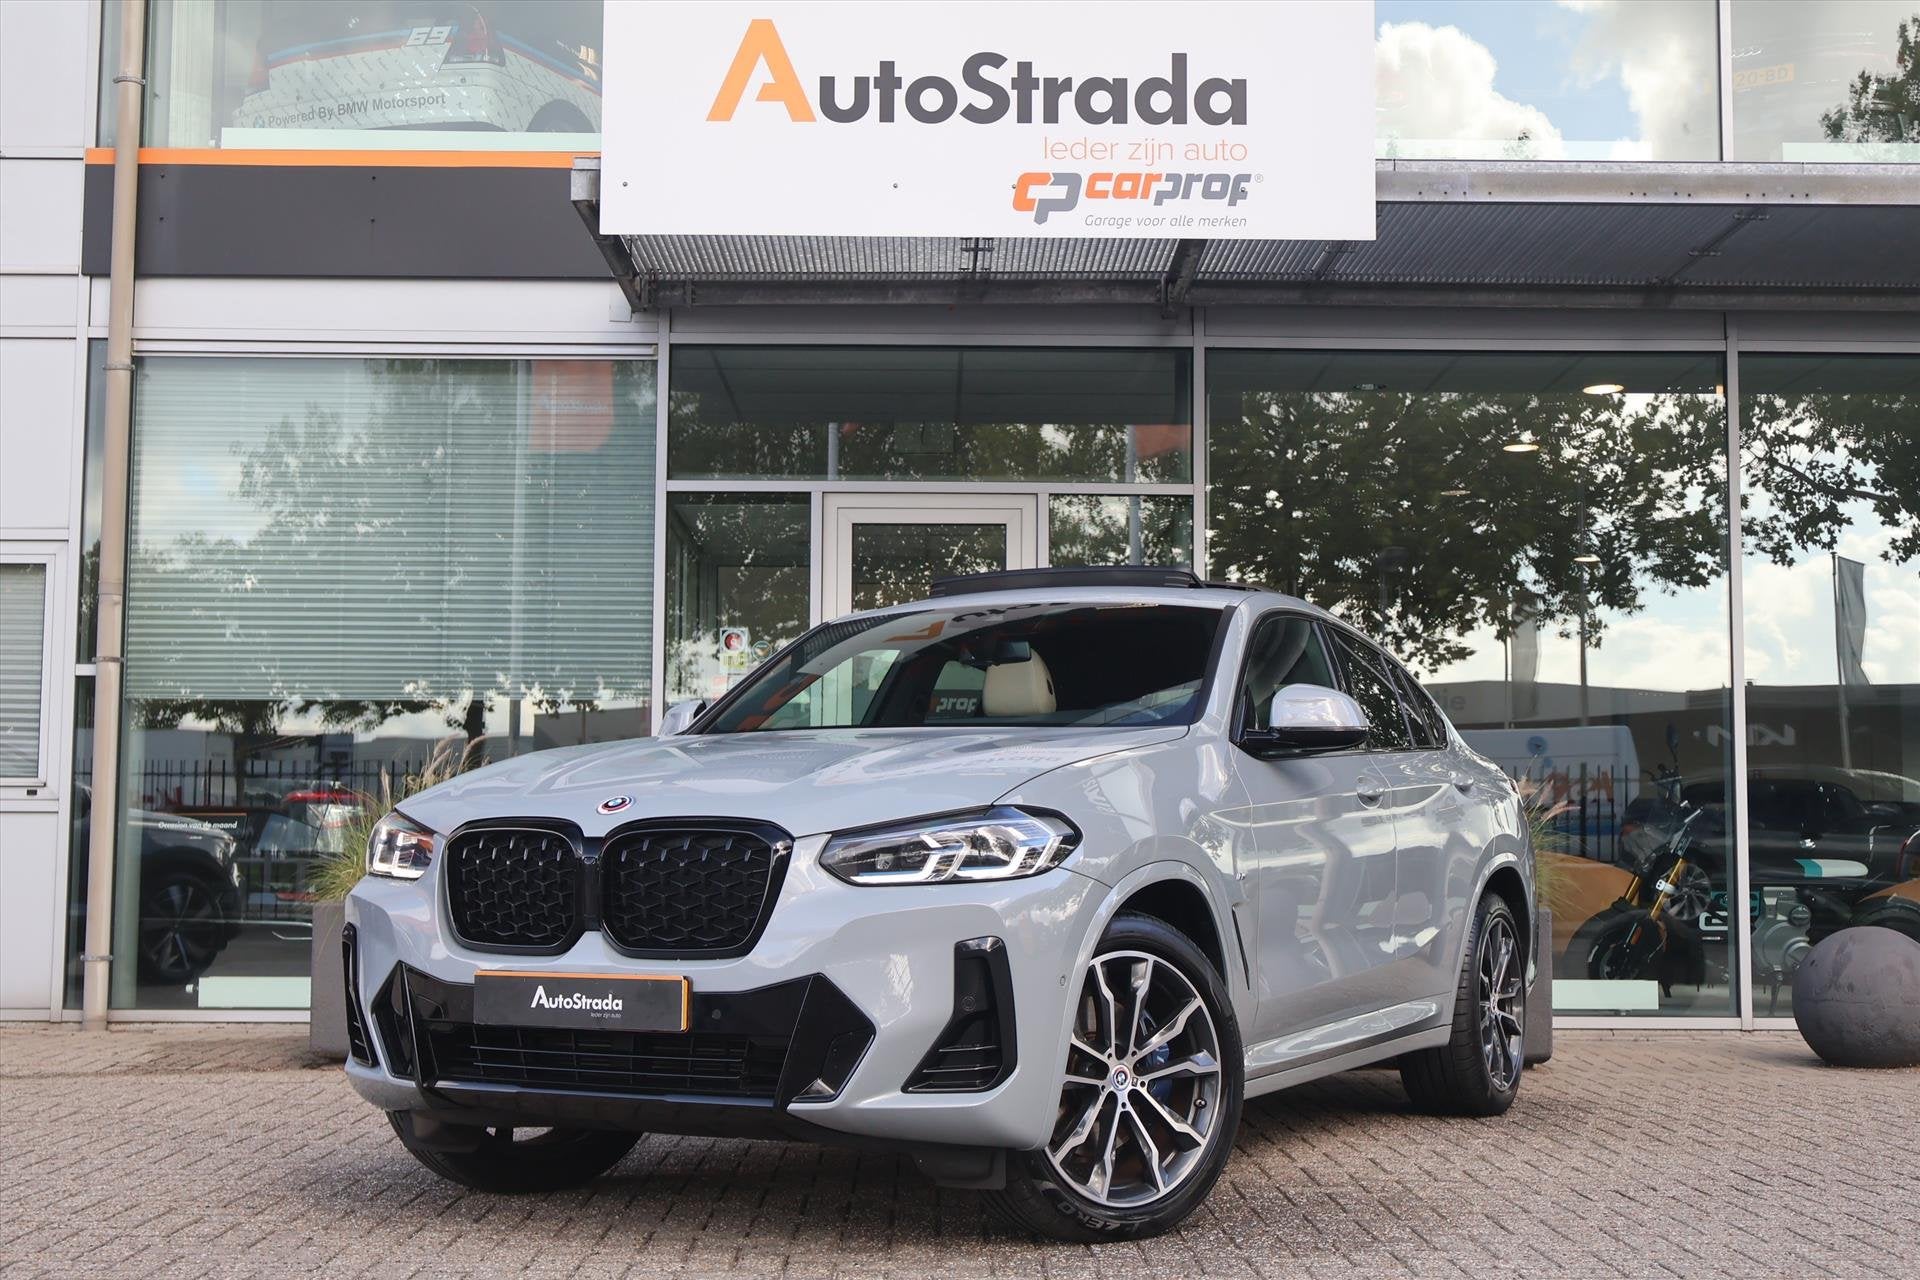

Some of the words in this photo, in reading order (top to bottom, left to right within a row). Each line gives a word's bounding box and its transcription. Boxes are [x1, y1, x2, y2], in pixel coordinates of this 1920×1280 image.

[407, 26, 451, 46] 69
[706, 19, 1247, 125] AutoStrada
[268, 106, 315, 127] Powered
[319, 106, 333, 121] By
[338, 101, 369, 116] BMW
[372, 93, 446, 111] Motorsport
[1044, 137, 1119, 161] Ieder
[1127, 137, 1174, 166] zijn
[1184, 139, 1248, 161] auto
[1084, 215, 1131, 230] Garage
[1136, 217, 1167, 228] voor
[1170, 215, 1194, 228] alle
[1198, 215, 1247, 228] merken
[203, 820, 212, 830] de
[213, 820, 237, 829] maand
[530, 984, 623, 1011] AutoStrada
